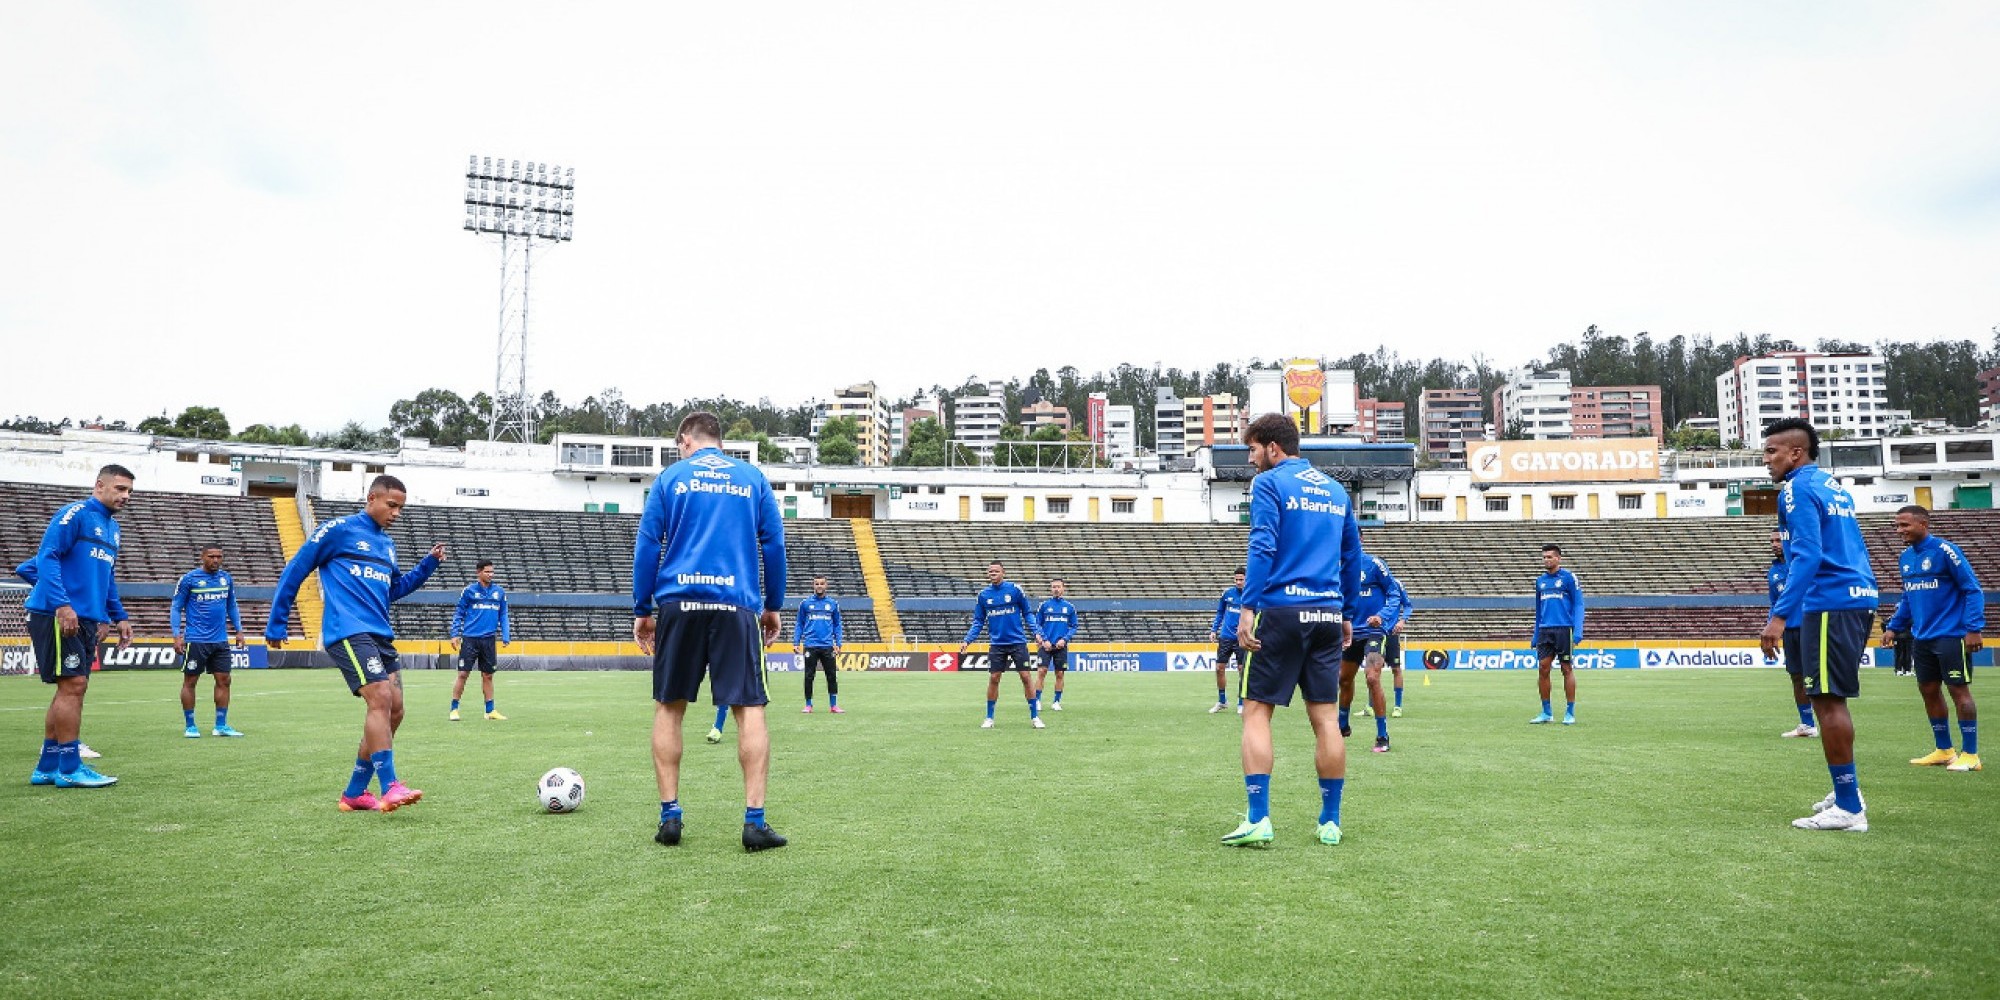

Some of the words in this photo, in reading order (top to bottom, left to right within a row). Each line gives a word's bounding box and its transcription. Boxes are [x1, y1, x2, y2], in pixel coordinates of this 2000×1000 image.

[1511, 450, 1654, 472] GATORADE
[694, 470, 731, 480] umbro
[690, 479, 751, 498] Banrisul
[1301, 486, 1331, 497] umbro
[1301, 498, 1346, 516] Banrisul
[678, 571, 735, 586] Unimed
[1300, 610, 1342, 623] Unime
[103, 647, 176, 666] LOTTO
[870, 656, 910, 668] SPORT
[1076, 654, 1139, 671] humana
[1454, 651, 1536, 669] LigaPro
[1665, 650, 1753, 666] Andalucía
